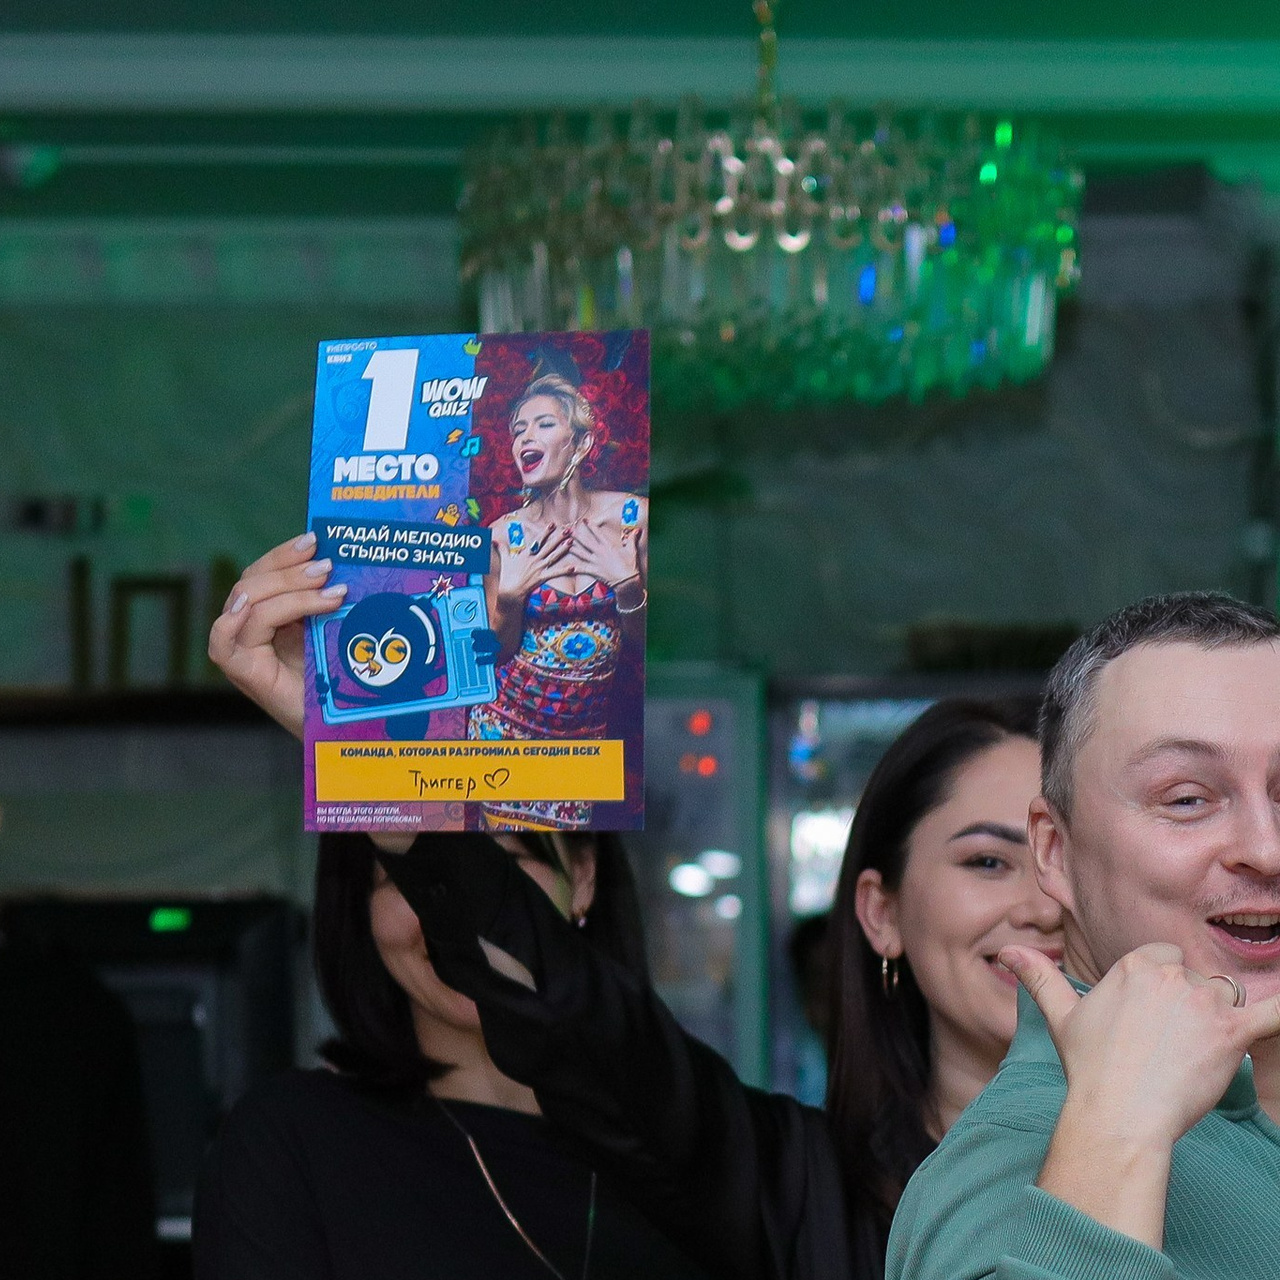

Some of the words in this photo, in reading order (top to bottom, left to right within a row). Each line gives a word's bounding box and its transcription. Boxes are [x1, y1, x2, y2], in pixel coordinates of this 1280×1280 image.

[361, 348, 419, 451] 1
[421, 376, 488, 403] WOW
[428, 400, 470, 418] QUIZ
[332, 453, 440, 483] МЕСТО
[331, 484, 441, 501] ПОБЕДИТЕЛИ
[326, 525, 390, 543] УГАДАЙ
[393, 529, 482, 549] МЕЛОДИЮ
[338, 543, 409, 563] СТЫДНО
[412, 548, 465, 566] ЗНАТЬ
[340, 747, 397, 758] КОМАНДА,
[399, 747, 447, 757] КОТОРАЯ
[449, 746, 520, 757] РАЗГРОМИЛА
[523, 746, 570, 757] СЕГОДНЯ
[573, 746, 600, 756] ВСЕХ
